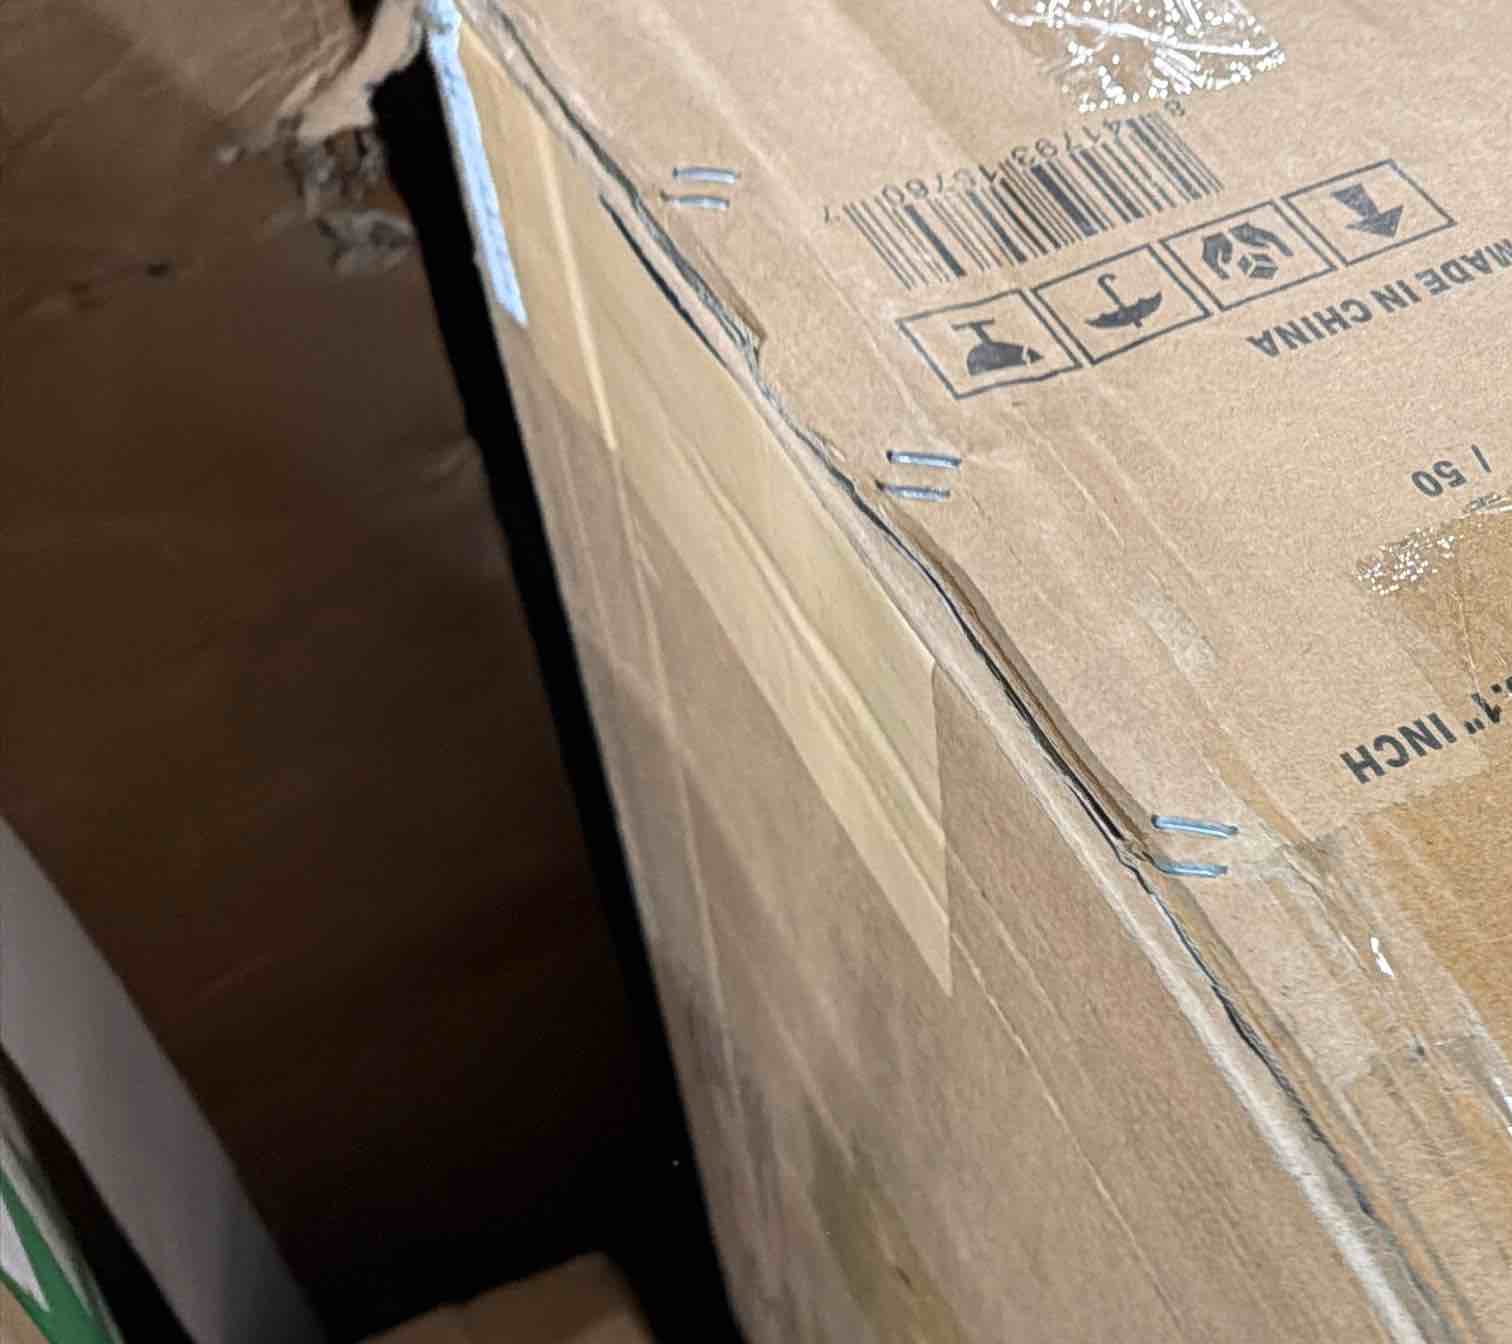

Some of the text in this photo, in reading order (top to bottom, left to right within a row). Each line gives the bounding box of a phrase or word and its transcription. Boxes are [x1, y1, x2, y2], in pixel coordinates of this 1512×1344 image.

[1370, 279, 1422, 313] IN
[1246, 299, 1372, 357] CHINA
[1411, 460, 1467, 497] 50
[1339, 713, 1457, 785] INCH
